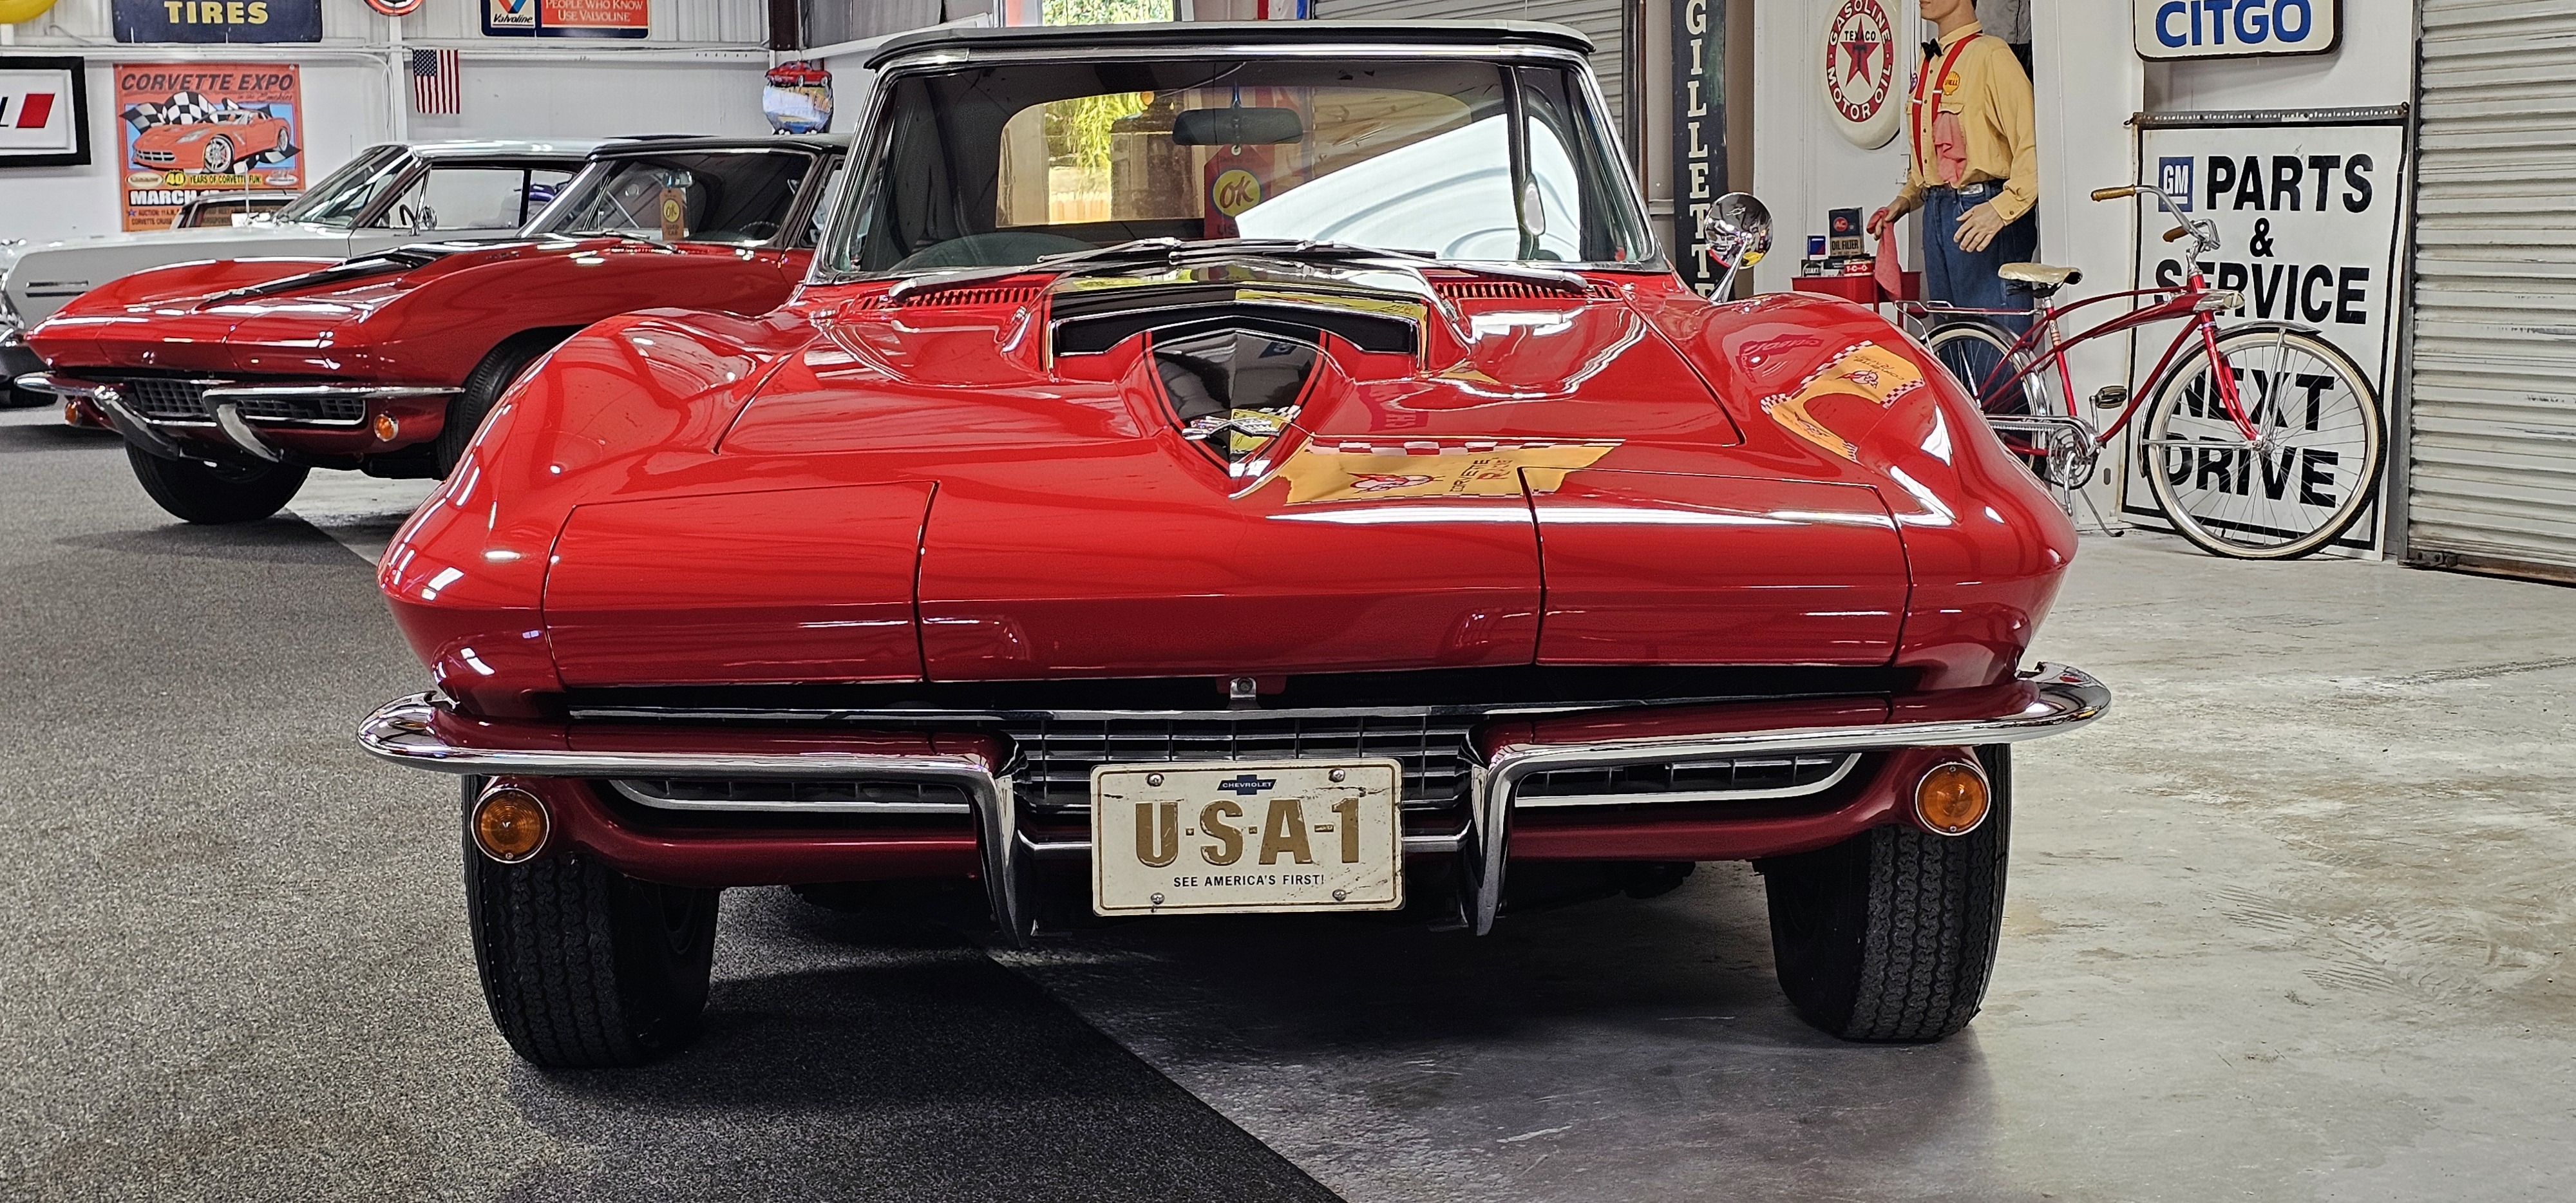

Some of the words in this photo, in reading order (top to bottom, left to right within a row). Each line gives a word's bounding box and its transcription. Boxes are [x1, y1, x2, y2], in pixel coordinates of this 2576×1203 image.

[164, 1, 268, 24] TIRES
[545, 0, 584, 9] PEOPLE
[586, 0, 611, 8] WHO
[612, 0, 643, 10] KNOW
[493, 14, 533, 23] Valvoline
[558, 12, 578, 21] USE
[579, 12, 630, 22] VALVOLINE
[1830, 0, 1890, 45] GASOLINE
[2155, 0, 2311, 48] CITGO
[1844, 31, 1876, 41] TEXACO
[121, 73, 234, 91] CORVETTE
[238, 73, 294, 91] EXPO
[1828, 66, 1871, 119] MOTOR
[1874, 64, 1891, 104] OIL
[167, 172, 184, 185] 40
[190, 175, 207, 184] YEARS
[211, 175, 216, 184] OF
[218, 175, 247, 184] CORVETT
[2163, 164, 2189, 195] GM
[2207, 153, 2374, 214] PARTS
[130, 189, 196, 205] MARCH
[1219, 175, 1255, 209] OK
[666, 204, 677, 218] OK
[1832, 241, 1841, 251] OIL
[1842, 240, 1859, 250] FILTER
[2249, 218, 2274, 257] &
[1173, 876, 1198, 887] SEE
[1204, 875, 1276, 887] AMERICA'S
[1282, 873, 1325, 886] FIRST!
